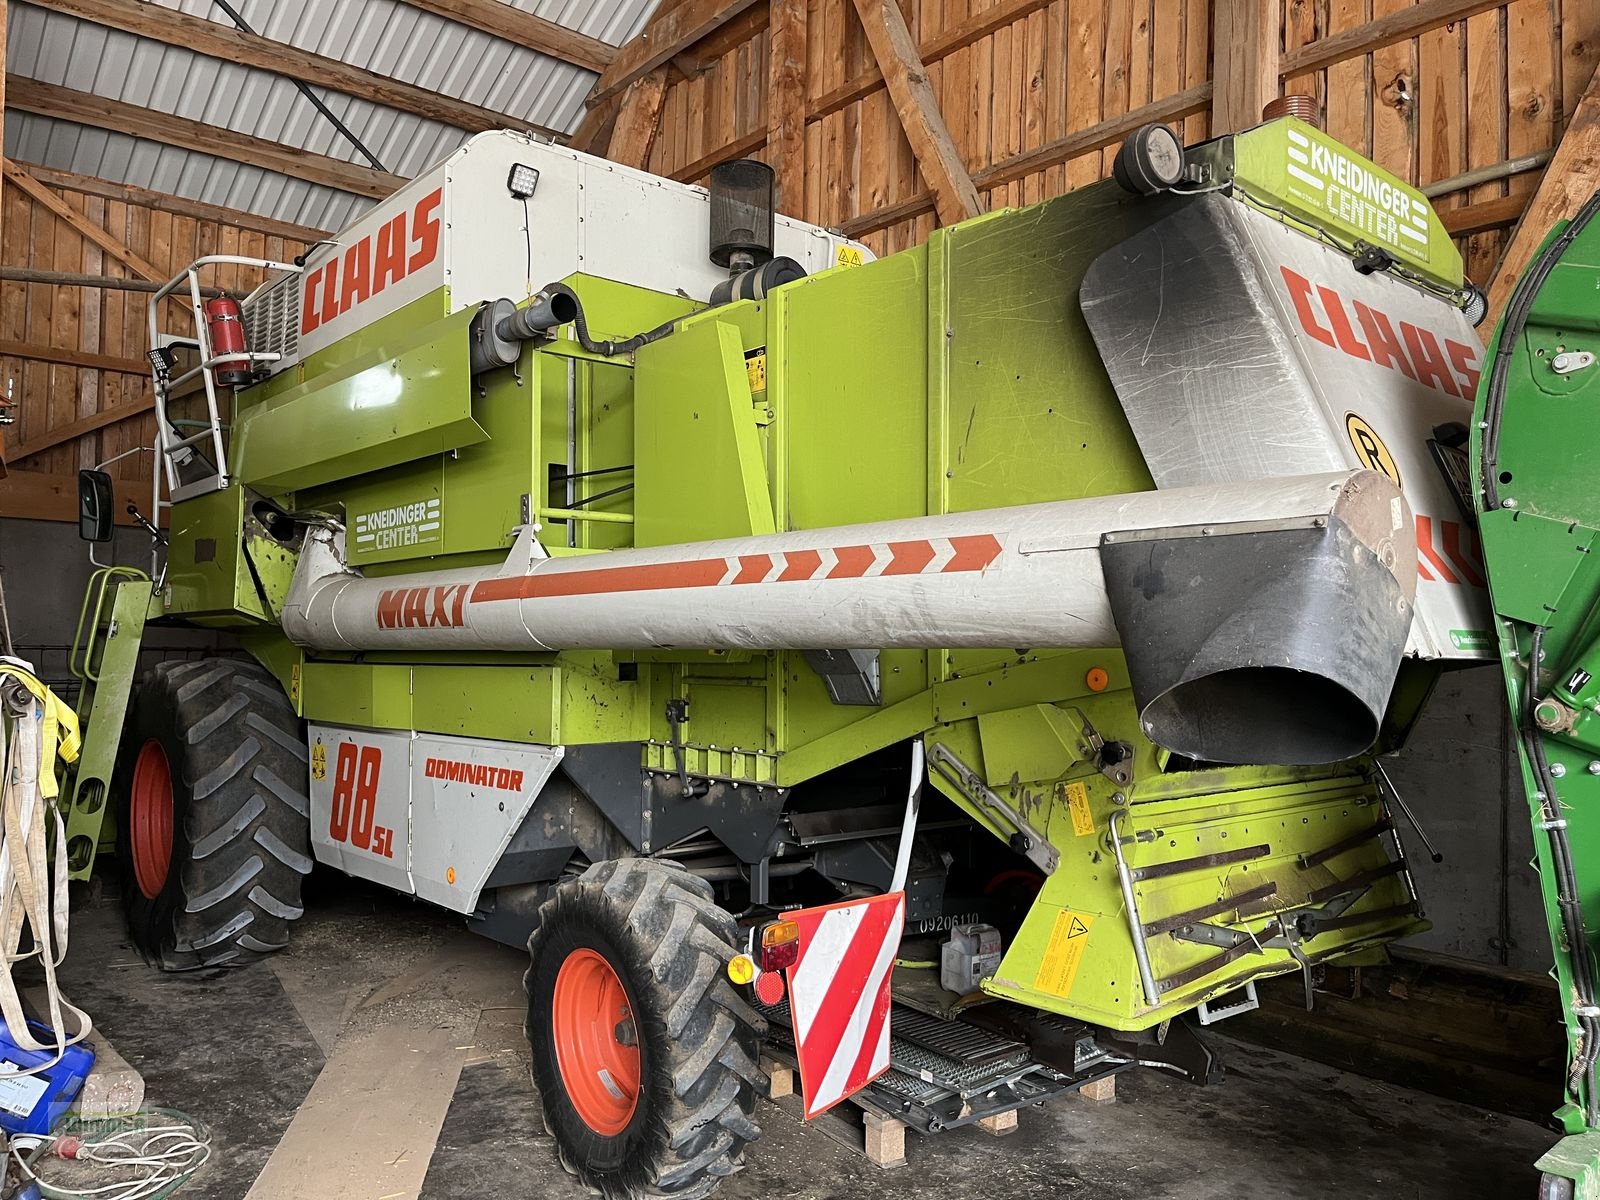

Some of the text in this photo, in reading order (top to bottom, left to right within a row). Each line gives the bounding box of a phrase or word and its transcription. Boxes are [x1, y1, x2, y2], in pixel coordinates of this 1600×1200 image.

[1311, 141, 1411, 221] KNEIDINGER
[1326, 183, 1399, 246] CENTER
[301, 187, 442, 336] CLAAS
[1279, 265, 1481, 402] CLAAS
[367, 502, 426, 531] KNEIDINGER
[376, 525, 418, 550] CENTER
[377, 584, 470, 629] MAXI
[425, 758, 524, 792] DOMINATOR
